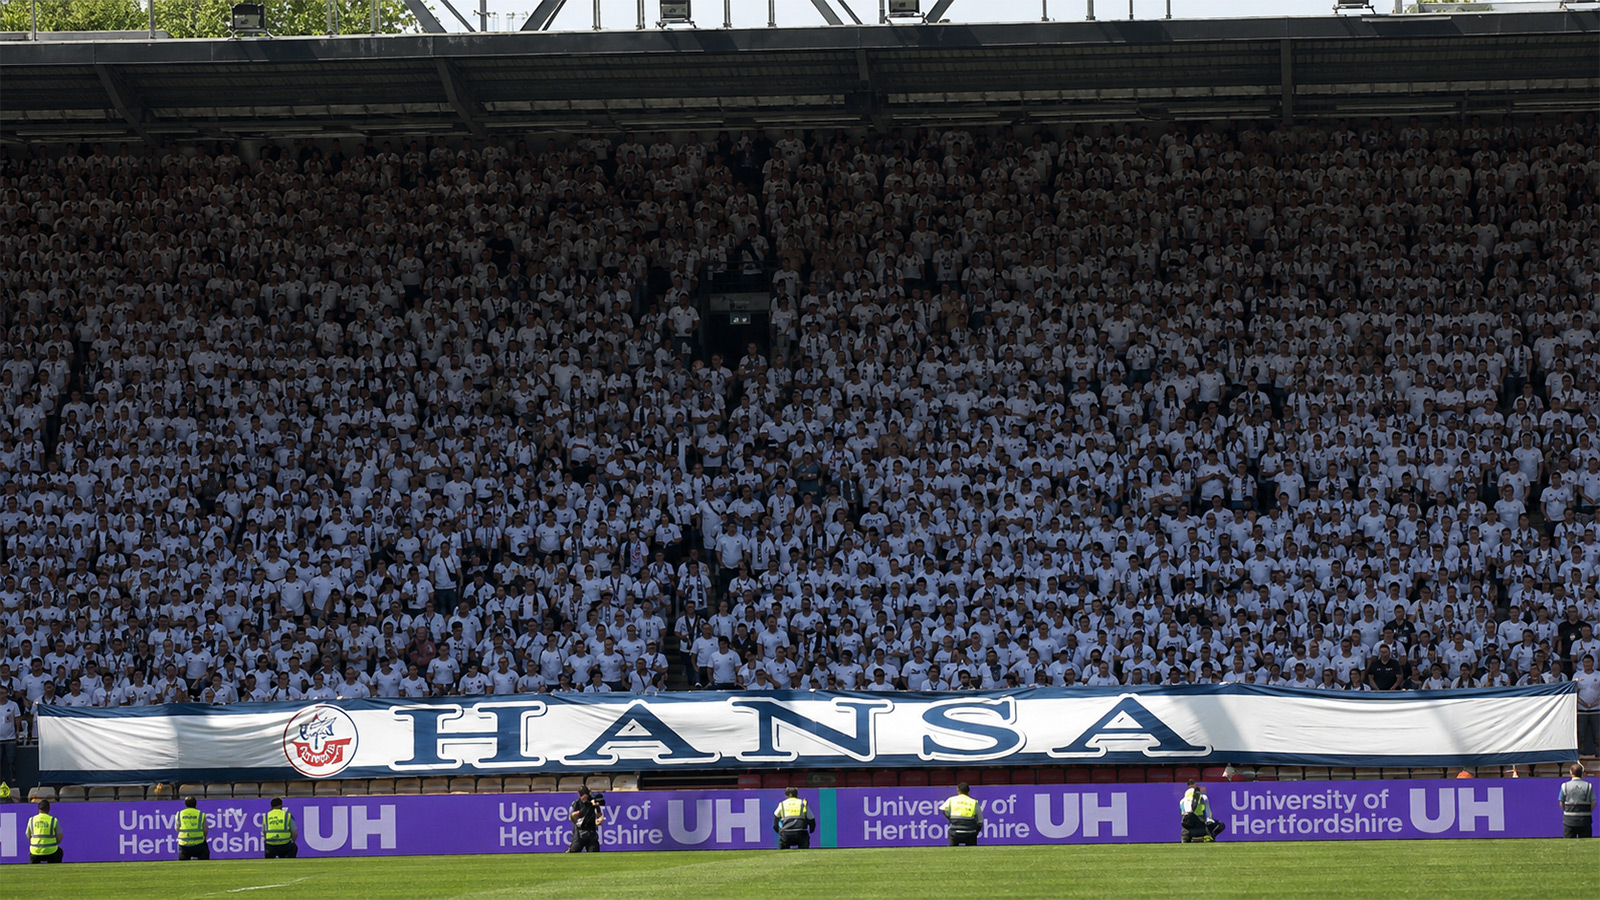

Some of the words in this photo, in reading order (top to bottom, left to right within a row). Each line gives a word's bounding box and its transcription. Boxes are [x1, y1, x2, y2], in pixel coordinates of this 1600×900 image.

[391, 693, 1212, 770] HANSA
[626, 800, 651, 821] of
[991, 794, 1017, 815] of
[1034, 792, 1129, 838] UH
[1231, 788, 1357, 814] University
[1364, 788, 1390, 810] of
[1409, 786, 1505, 834] UH
[119, 808, 248, 833] Univsity
[303, 804, 397, 851] UH
[667, 798, 761, 845] UH
[1231, 812, 1403, 835] Hertfordshire
